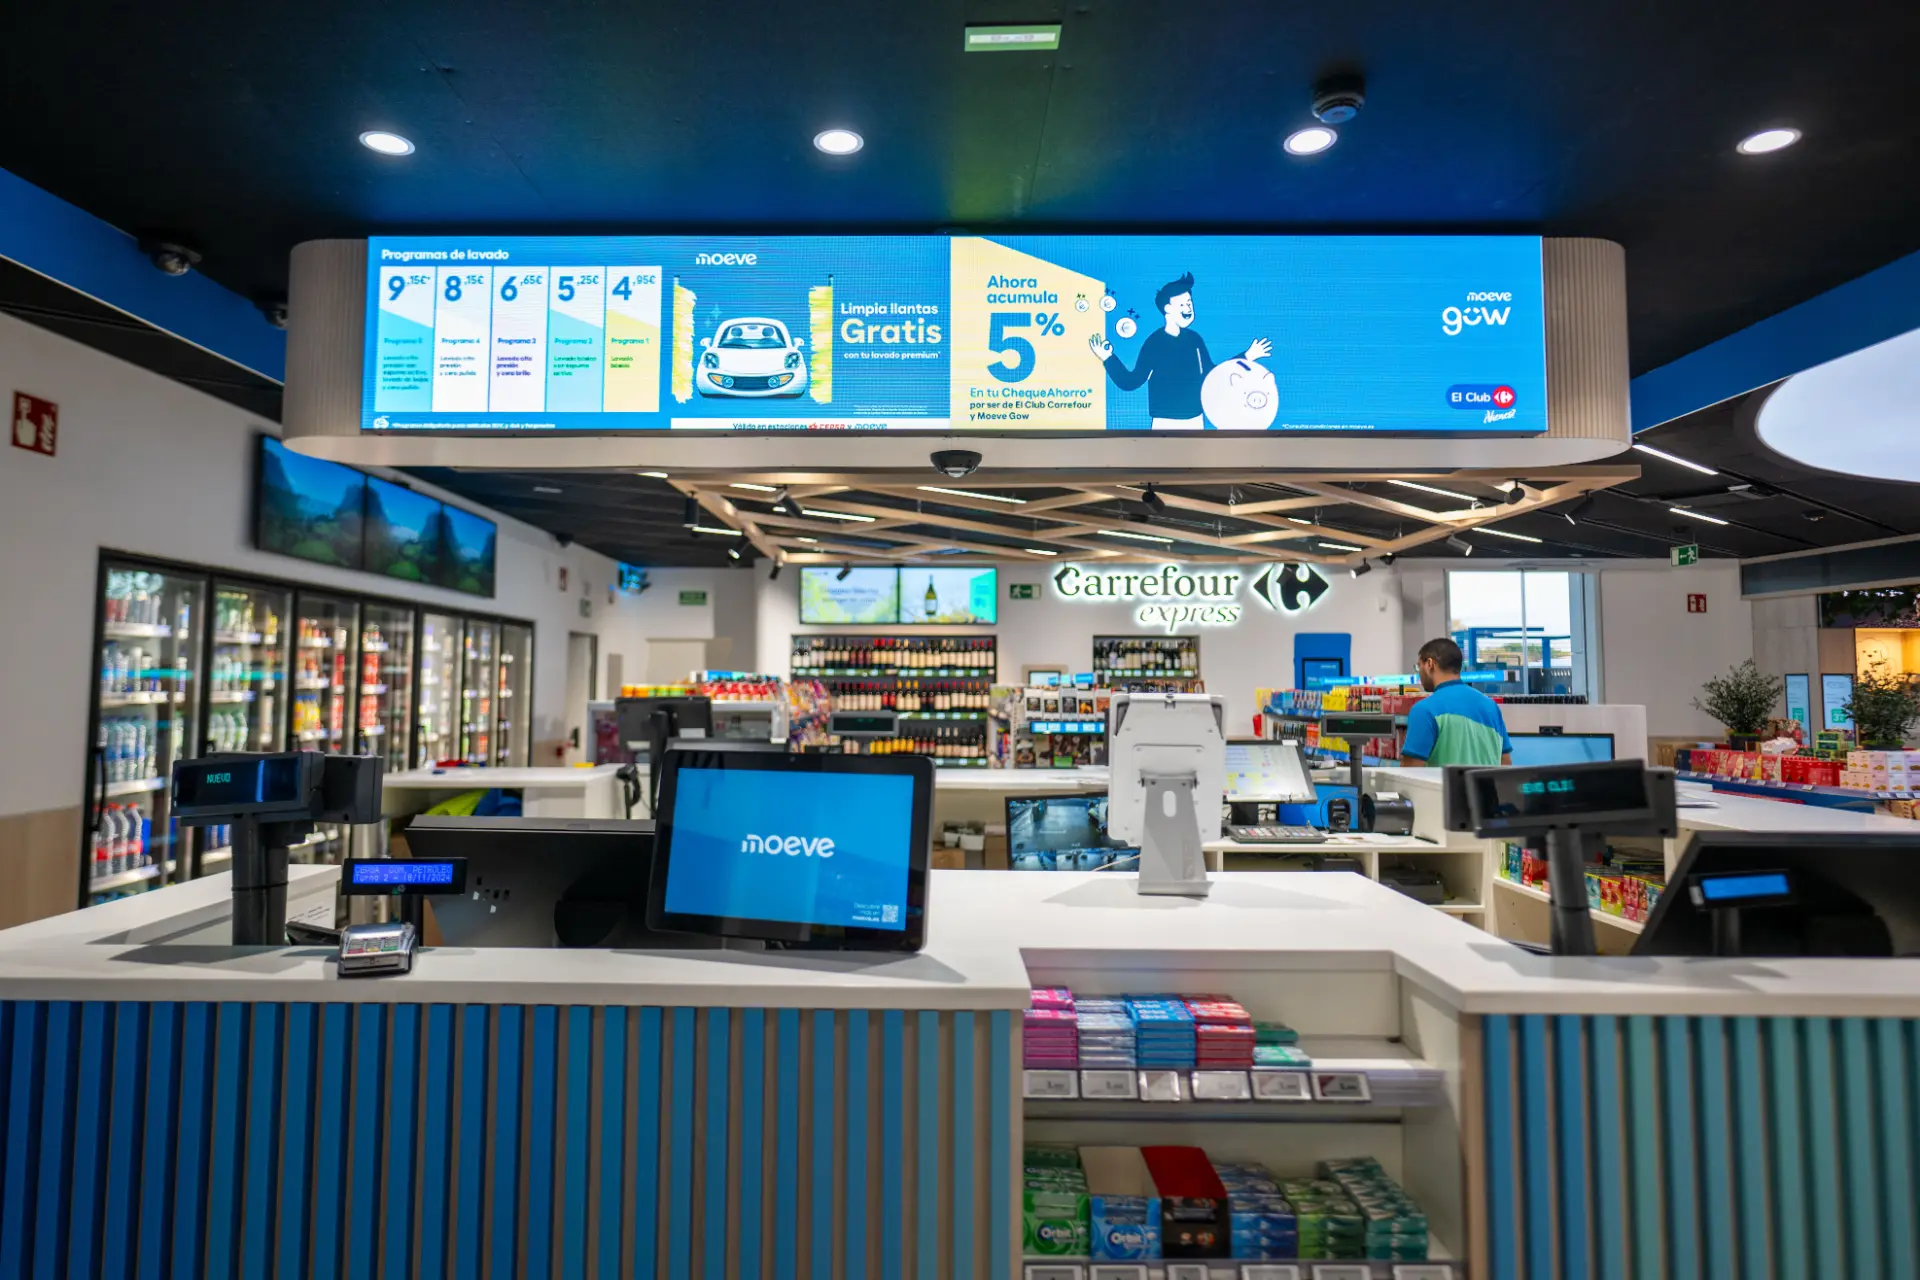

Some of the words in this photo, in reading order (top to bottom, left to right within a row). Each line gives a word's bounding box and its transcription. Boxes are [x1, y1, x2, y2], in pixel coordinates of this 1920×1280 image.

[381, 249, 448, 262] Programas
[450, 249, 465, 260] de
[467, 249, 509, 260] lavado
[696, 253, 757, 265] moeve
[987, 275, 1037, 288] Ahora
[987, 291, 1058, 304] acumula
[1466, 291, 1512, 301] moeve
[841, 303, 887, 317] Limpia
[890, 303, 938, 314] llantas
[841, 318, 942, 344] Gratis
[987, 312, 1065, 383] 5%
[970, 388, 984, 397] En
[987, 388, 999, 397] tu
[1451, 392, 1462, 402] El
[1465, 392, 1491, 402] Club
[970, 413, 975, 421] y
[977, 412, 1007, 420] Moeve
[1009, 412, 1029, 420] Gow
[1054, 565, 1240, 597] Carrefour
[1140, 604, 1241, 632] express
[207, 773, 231, 783] NUEVO
[740, 833, 835, 858] moeve
